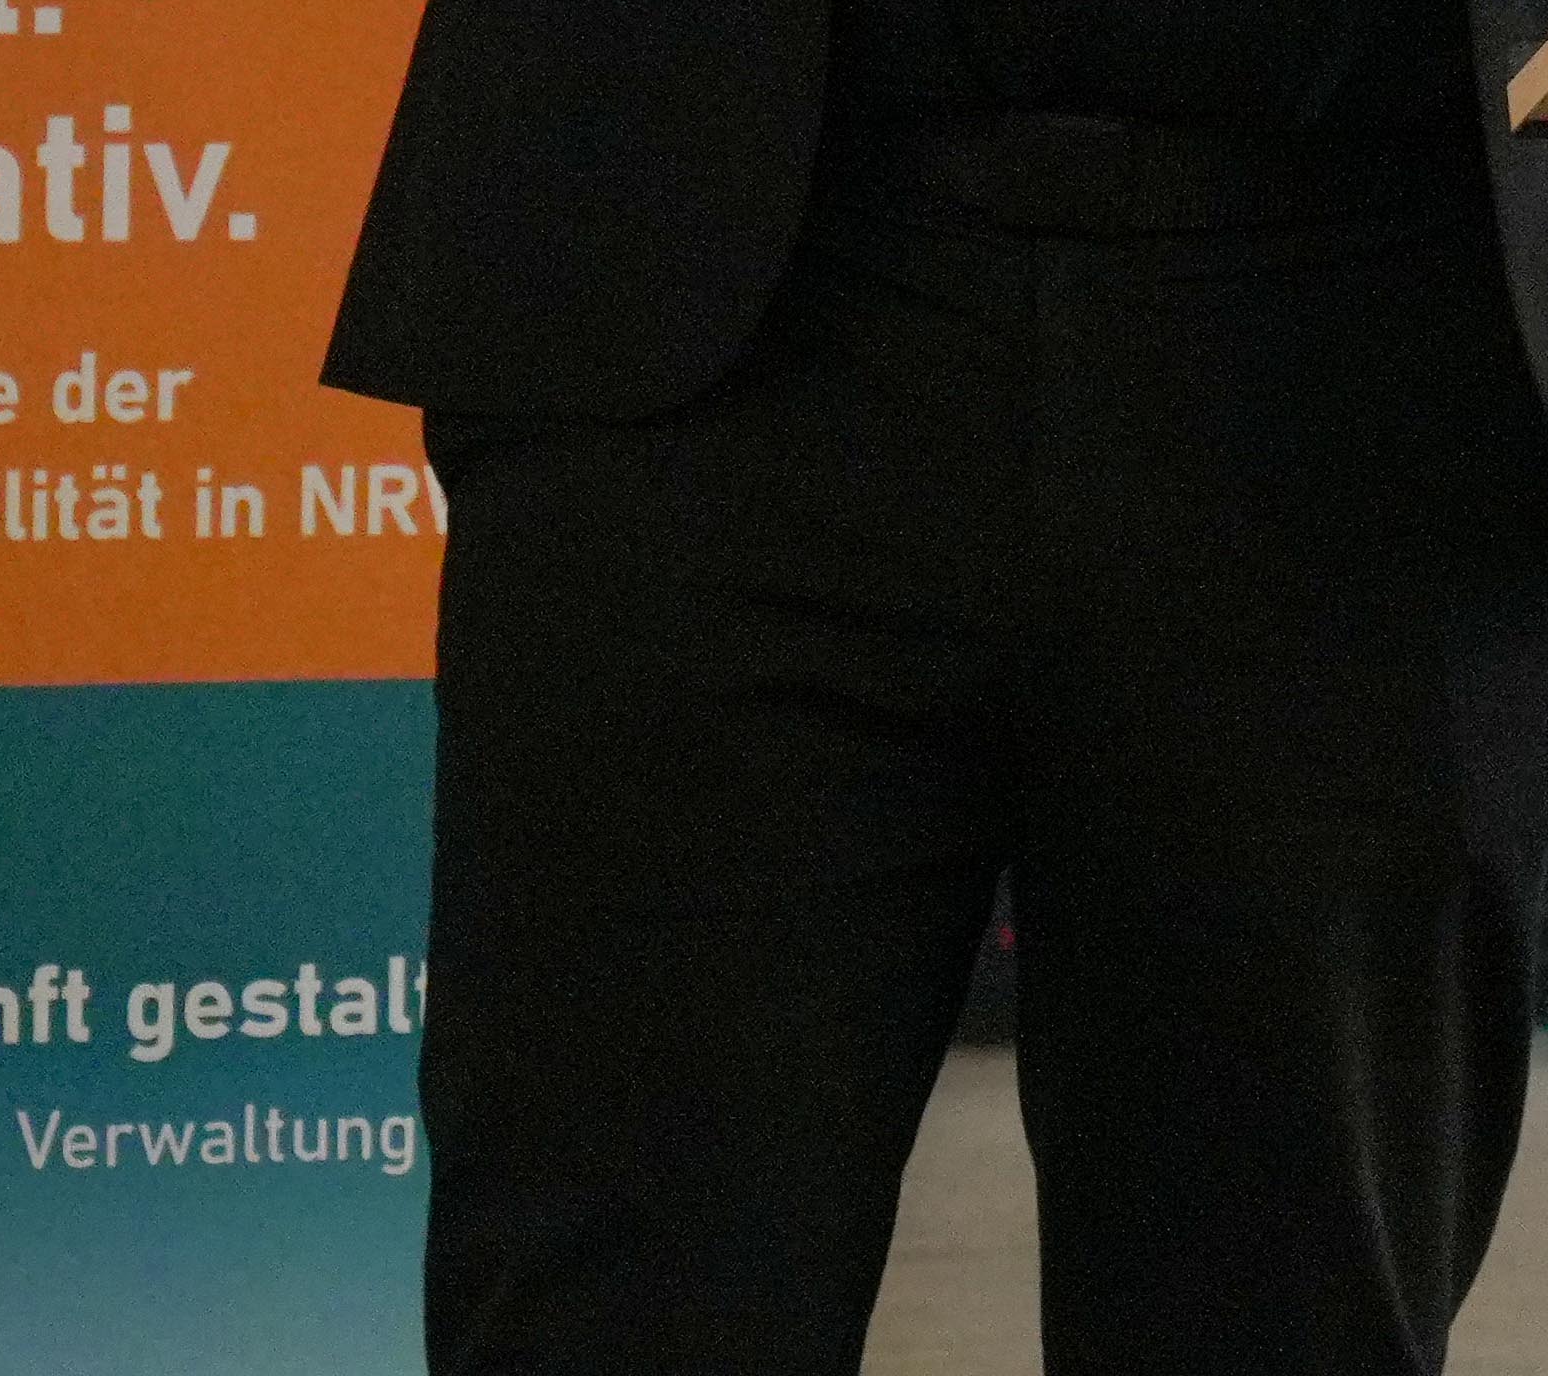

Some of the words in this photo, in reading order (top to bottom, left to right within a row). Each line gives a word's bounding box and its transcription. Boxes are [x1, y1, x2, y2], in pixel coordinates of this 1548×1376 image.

[53, 351, 194, 422] der
[196, 467, 265, 537] in
[18, 1104, 415, 1175] Verwaltung
